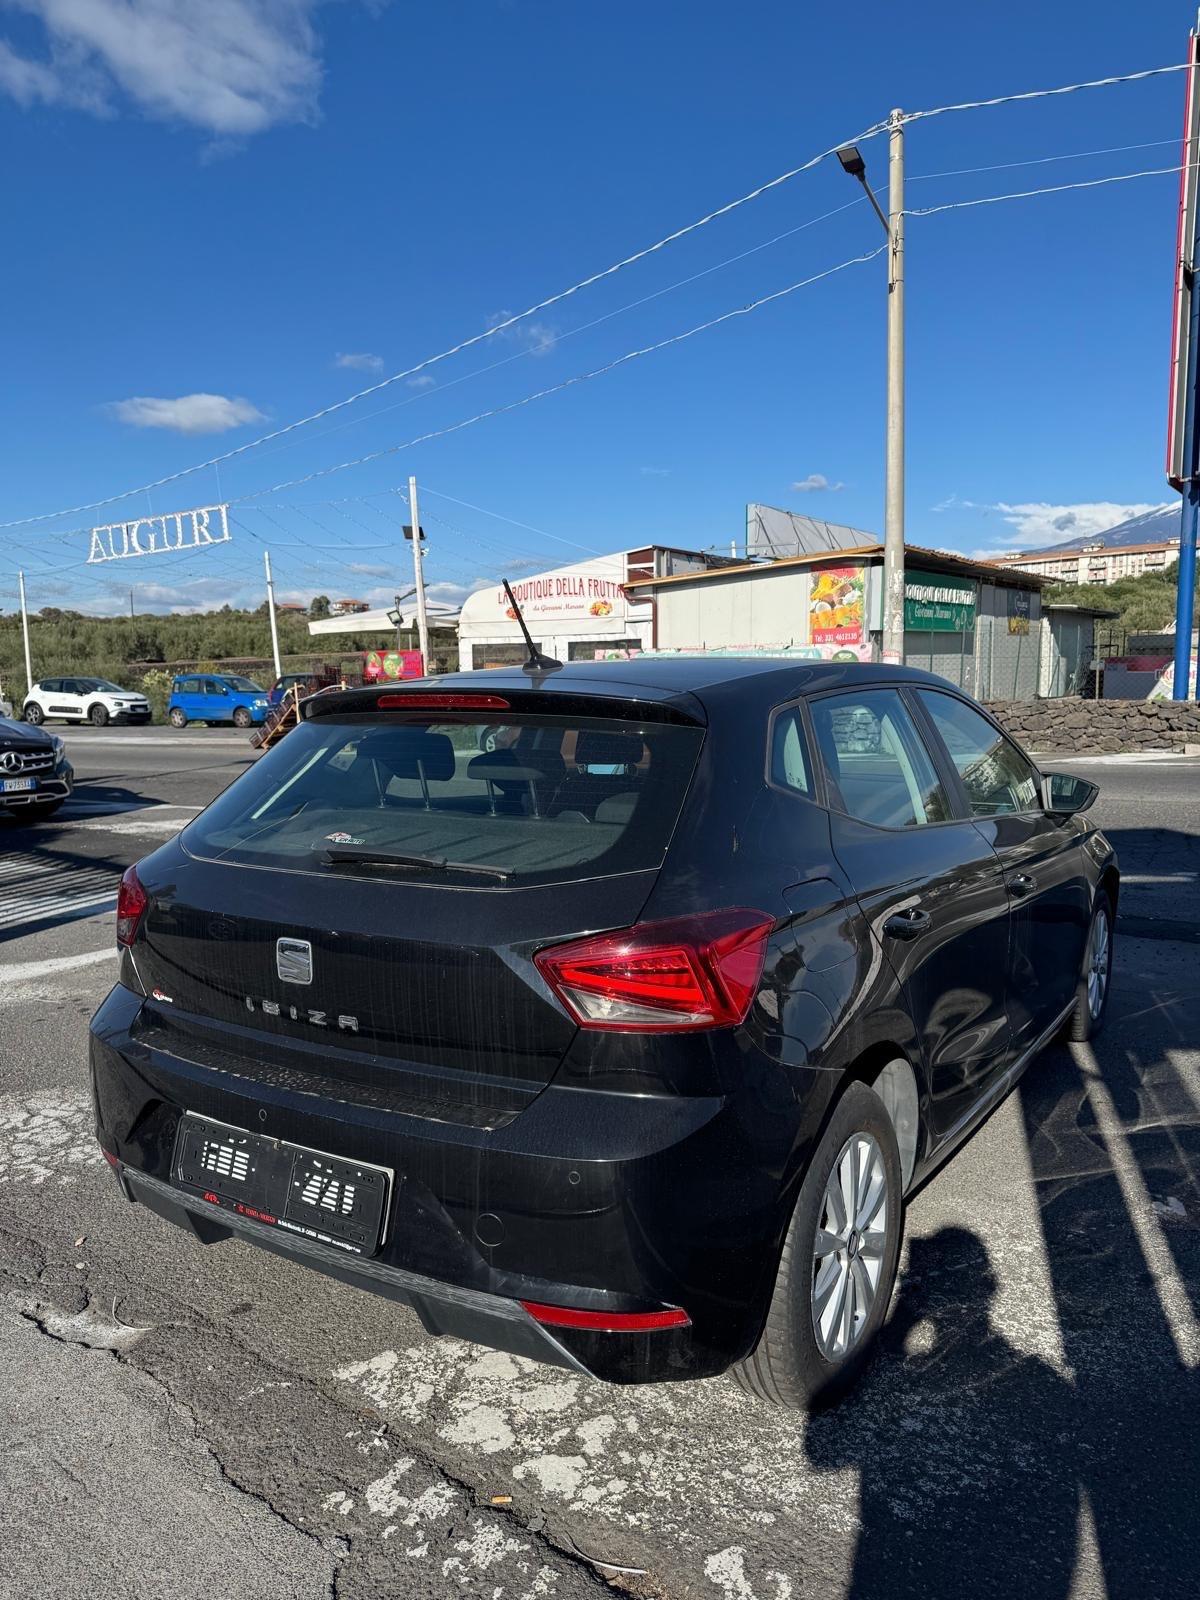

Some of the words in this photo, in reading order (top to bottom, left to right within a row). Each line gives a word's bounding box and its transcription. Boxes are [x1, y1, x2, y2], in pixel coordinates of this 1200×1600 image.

[86, 504, 232, 563] AUGURI
[512, 579, 553, 601] BOUTIQUE
[556, 577, 585, 597] DELLA
[588, 578, 625, 599] FRUTTA
[246, 996, 359, 1032] IBIZA
